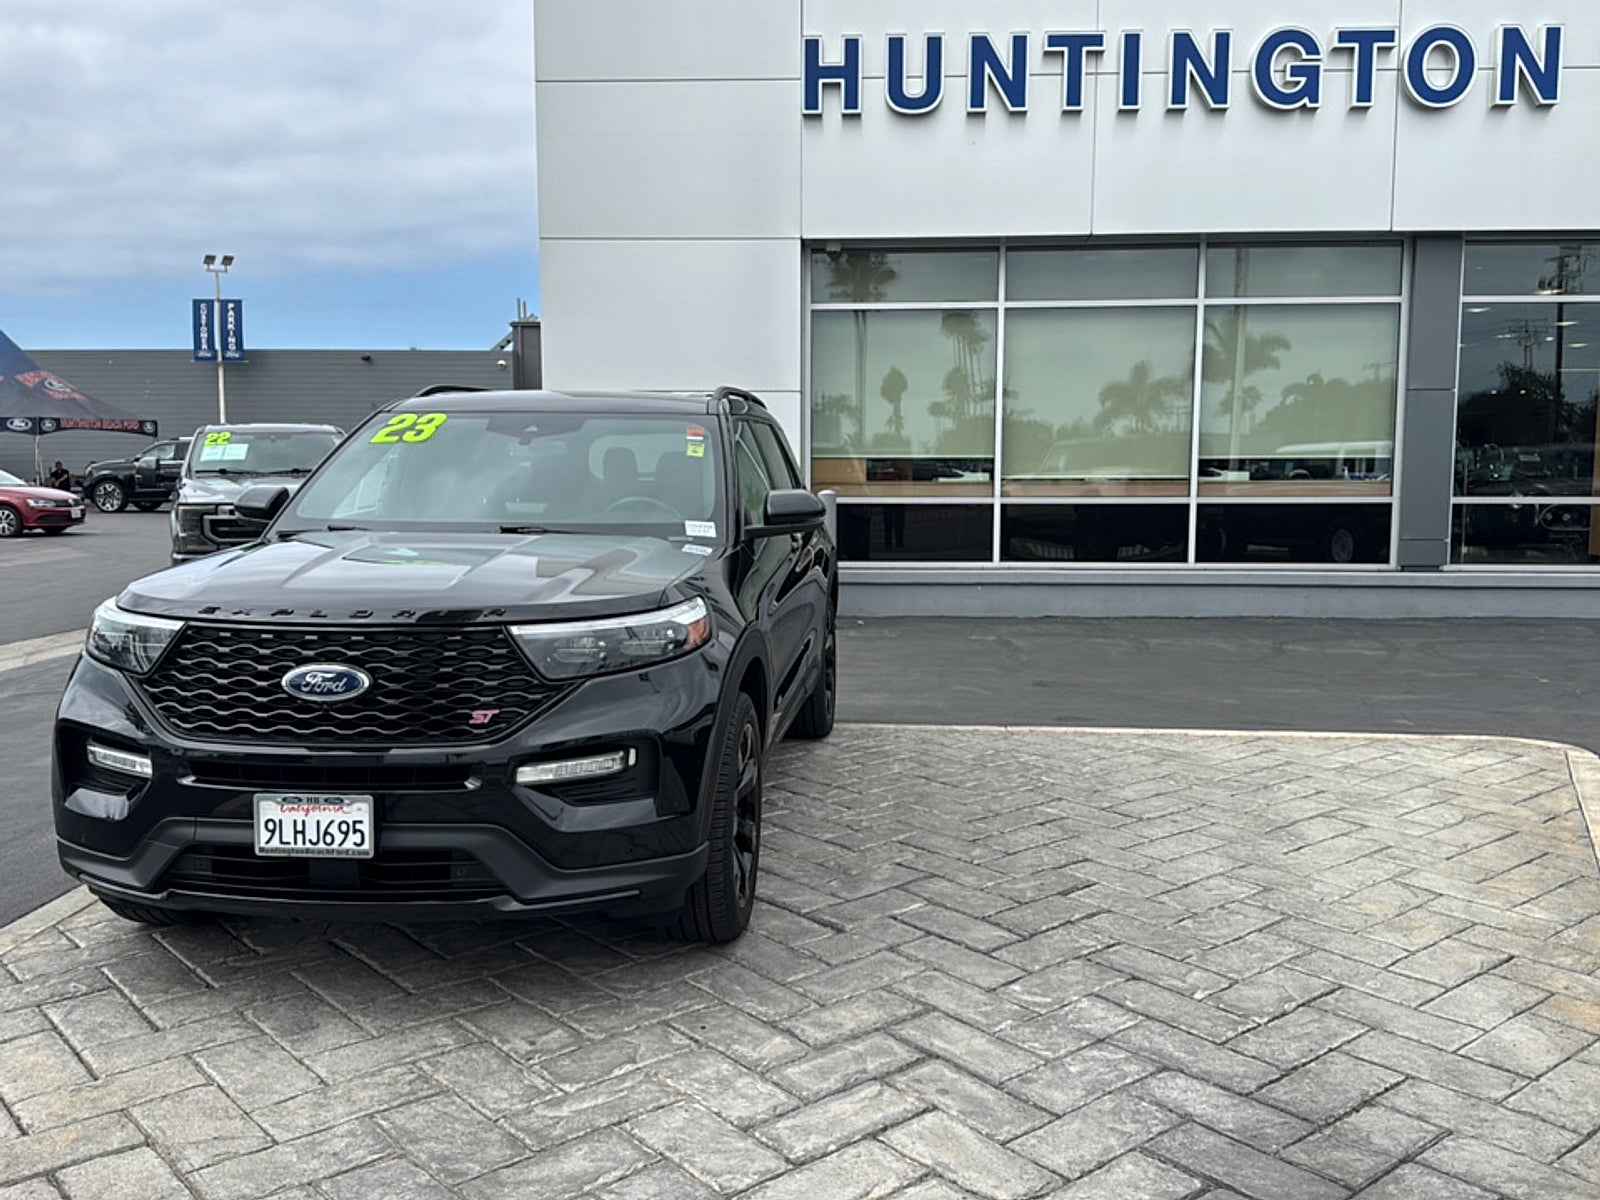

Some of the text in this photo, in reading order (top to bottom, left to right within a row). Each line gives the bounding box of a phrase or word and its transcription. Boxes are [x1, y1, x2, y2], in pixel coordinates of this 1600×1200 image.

[801, 24, 1563, 117] HUNTINGTON
[200, 303, 208, 350] CUSTOMER
[227, 303, 236, 350] PARKING
[204, 432, 231, 447] 22
[369, 413, 448, 443] 23
[198, 606, 507, 620] EXPLORR
[301, 671, 348, 692] Ford
[469, 709, 500, 724] ST
[264, 818, 365, 847] 9LHJ695
